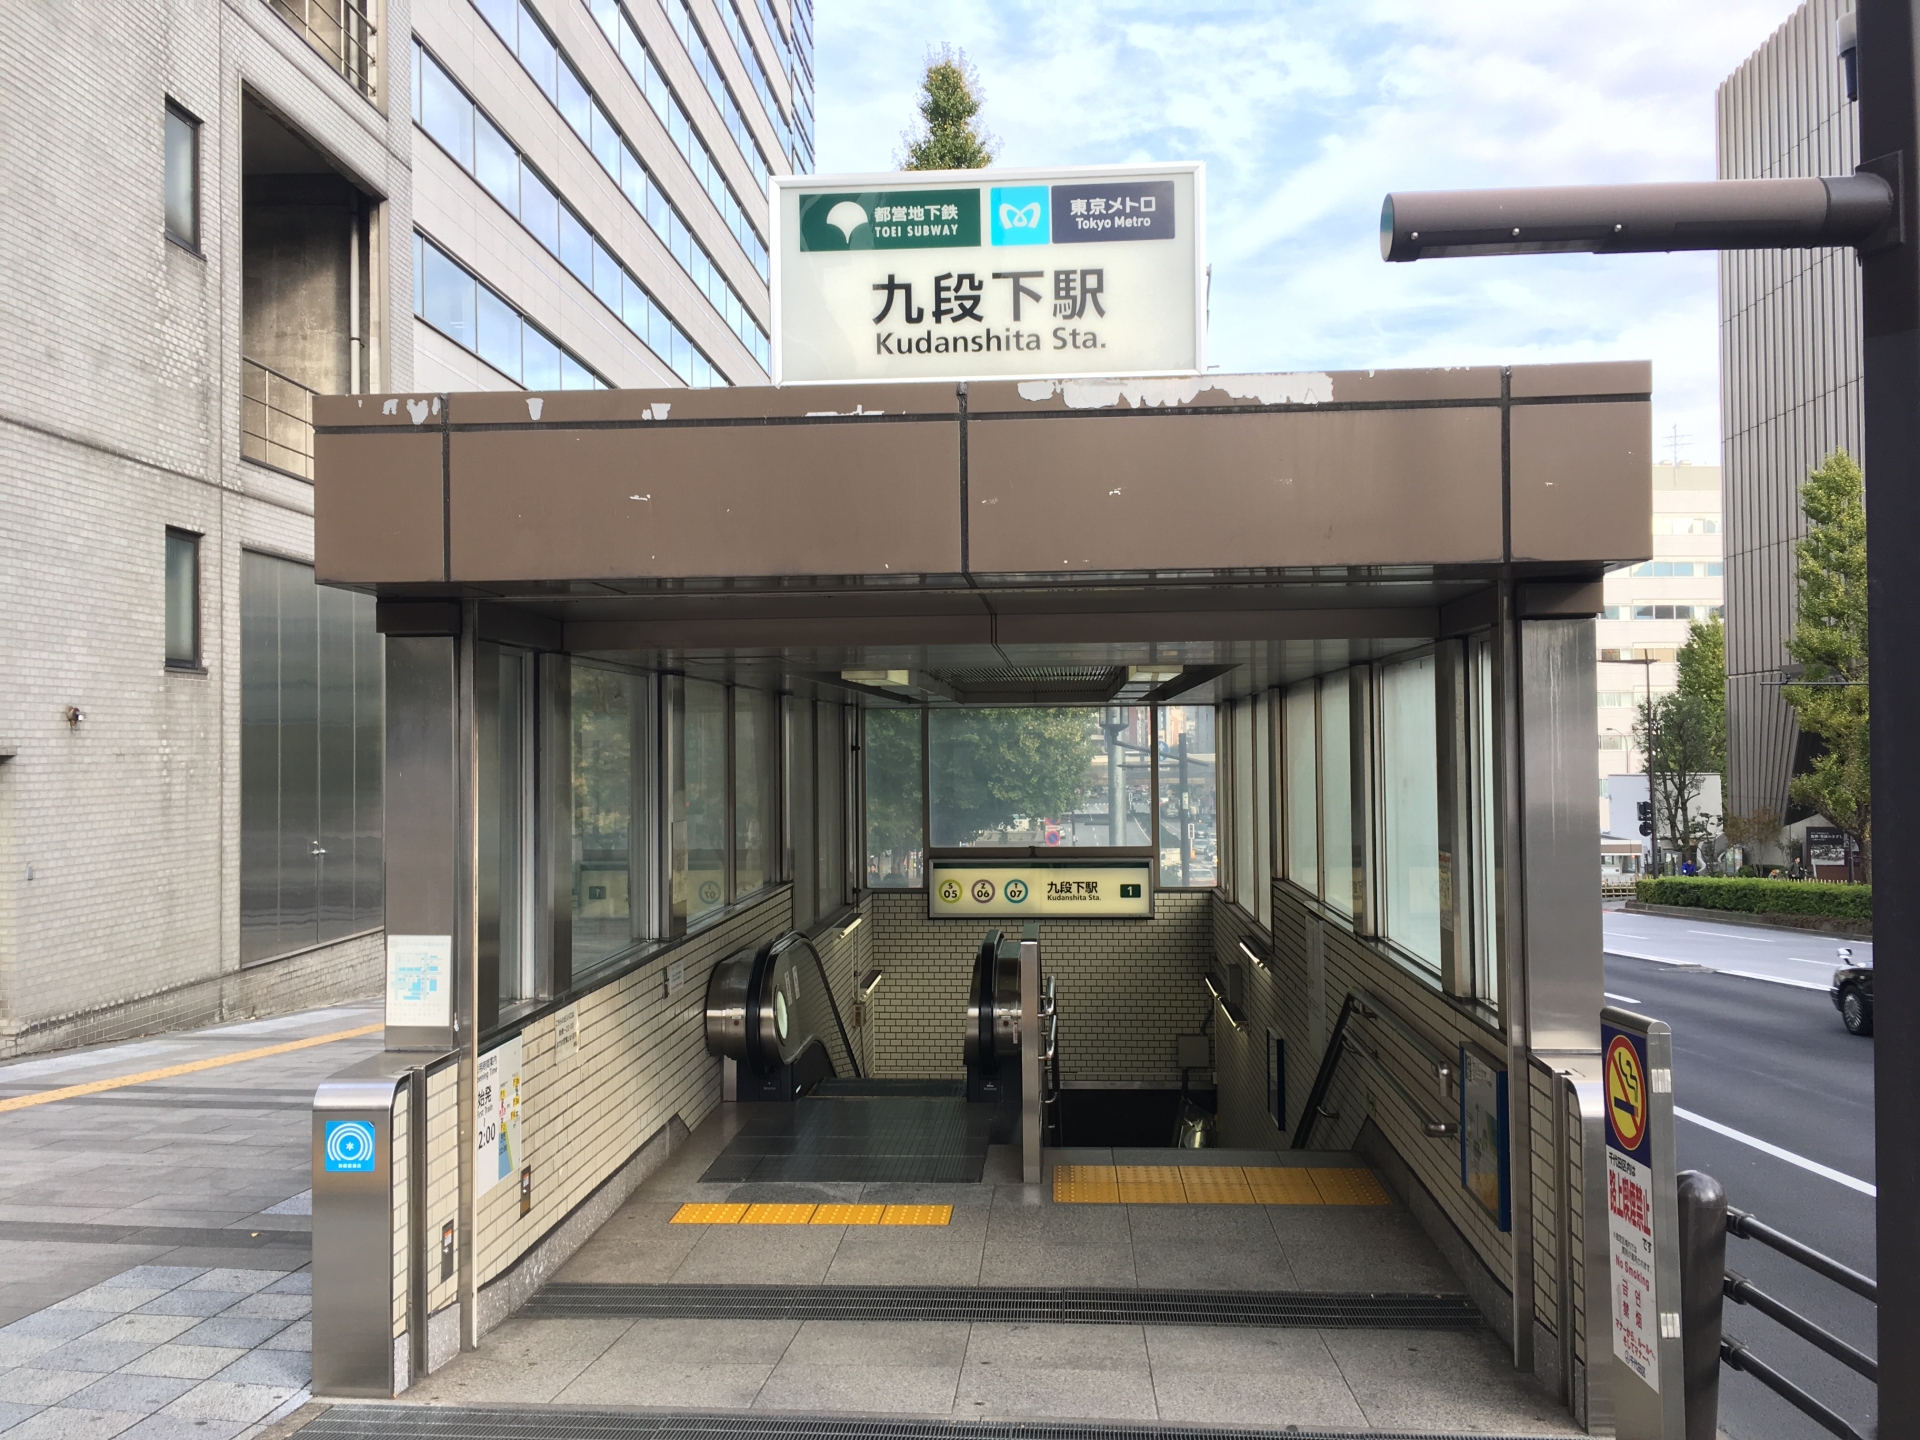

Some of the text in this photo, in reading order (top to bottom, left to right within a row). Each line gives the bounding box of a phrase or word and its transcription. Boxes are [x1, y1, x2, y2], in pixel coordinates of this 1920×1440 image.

[874, 204, 958, 222] 都営地下鉄
[1070, 196, 1156, 216] 東京メトロ
[1076, 215, 1151, 231] Tokyo Metro
[875, 224, 958, 238] TOEI SUBWAY
[872, 268, 1106, 326] 九段下駅
[876, 326, 1107, 356] Kudanshita Sta.
[947, 882, 954, 890] S
[980, 882, 986, 890] Z
[1013, 882, 1019, 890] T
[1047, 881, 1098, 894] 九段下駅
[1127, 886, 1133, 896] 1
[943, 890, 958, 898] 05
[976, 890, 990, 898] 06
[1009, 890, 1023, 898] 07
[1608, 1152, 1636, 1177] 千代田区内は
[1642, 1237, 1652, 1254] です
[1615, 1254, 1650, 1292] No Smoking
